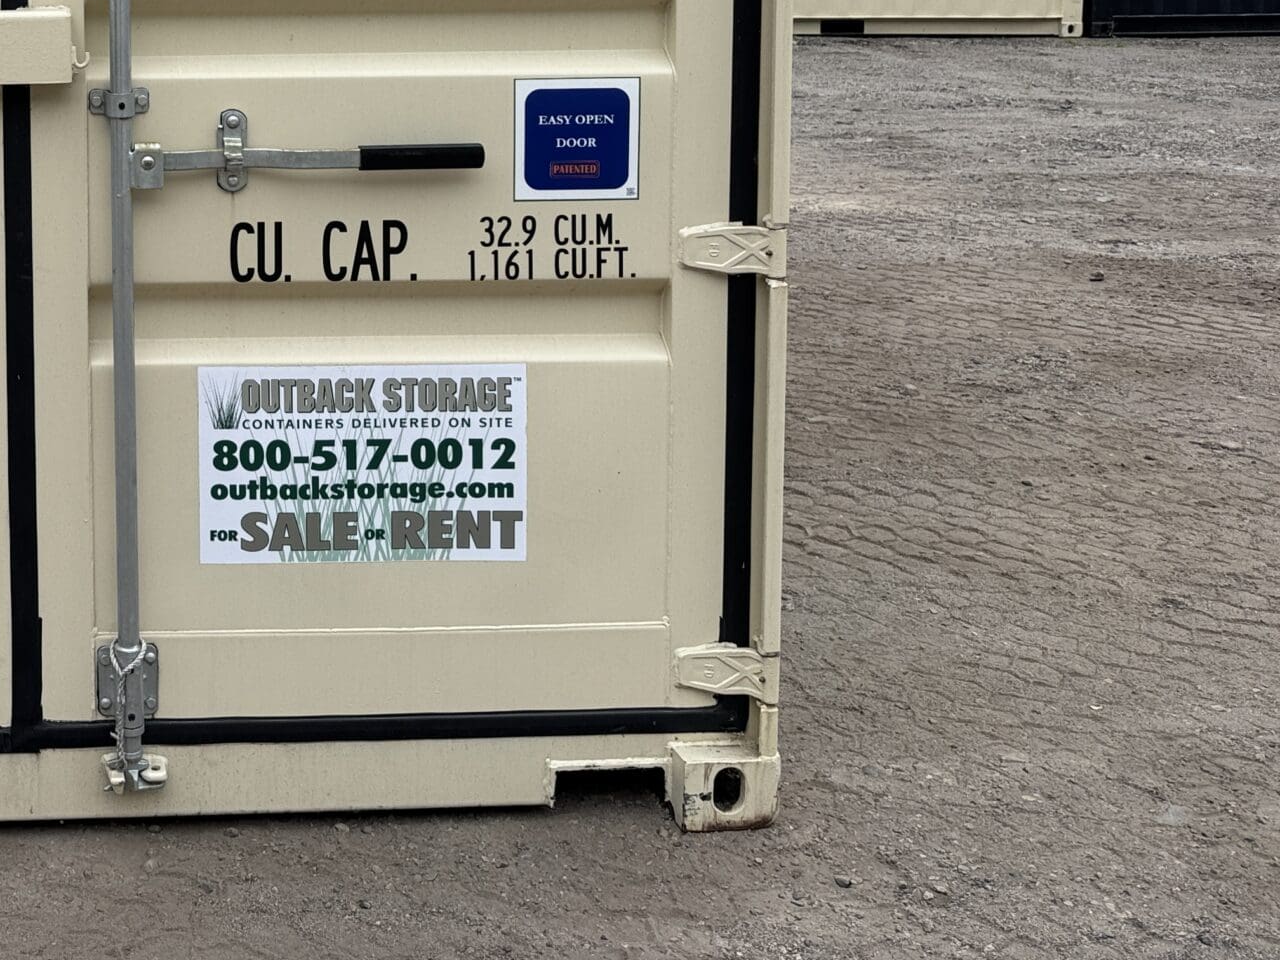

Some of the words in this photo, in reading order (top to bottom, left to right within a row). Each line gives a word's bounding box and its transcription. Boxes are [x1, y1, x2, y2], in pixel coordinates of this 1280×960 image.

[538, 115, 573, 126] EASY
[575, 114, 615, 125] OPEN
[556, 137, 598, 148] DOOR
[552, 164, 597, 174] PATENTED
[229, 221, 292, 284] CU.
[322, 219, 418, 283] CAP.
[479, 215, 537, 248] 32.9
[554, 213, 620, 246] CU.M.
[467, 248, 534, 281] 1,161
[554, 246, 636, 280] CU.FT.
[241, 377, 375, 414] OUTBACK
[382, 376, 512, 413] STORAGE
[242, 418, 344, 430] CONTAINERS
[352, 417, 441, 429] DELIVERED
[449, 417, 471, 428] ON
[479, 417, 513, 428] SITE
[212, 438, 516, 472] 800-517-0012
[210, 476, 515, 504] outbackstorage.com
[210, 529, 239, 542] FOR
[240, 511, 359, 552] SALE
[364, 528, 386, 541] OR
[390, 510, 524, 550] RENT
